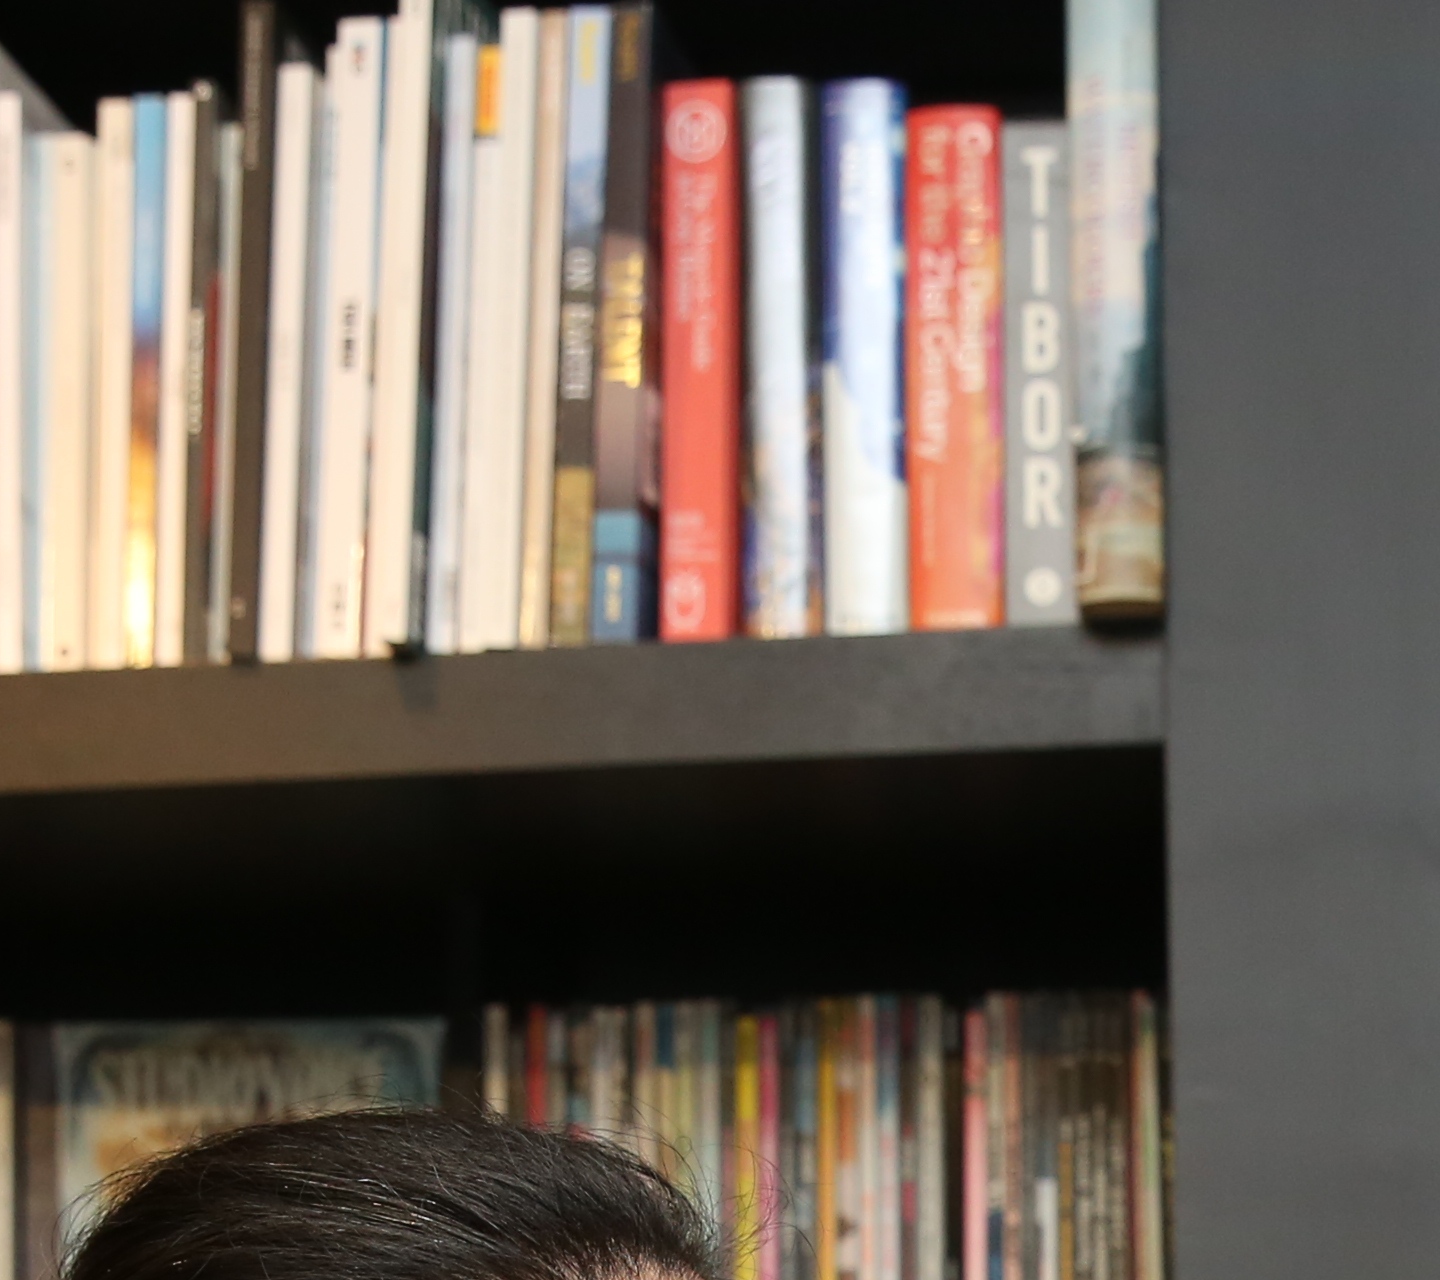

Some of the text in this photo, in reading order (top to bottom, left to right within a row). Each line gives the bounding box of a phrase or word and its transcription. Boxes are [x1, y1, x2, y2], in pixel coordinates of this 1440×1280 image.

[915, 321, 956, 463] Century
[949, 267, 993, 394] Design
[1017, 145, 1062, 529] TIBOR
